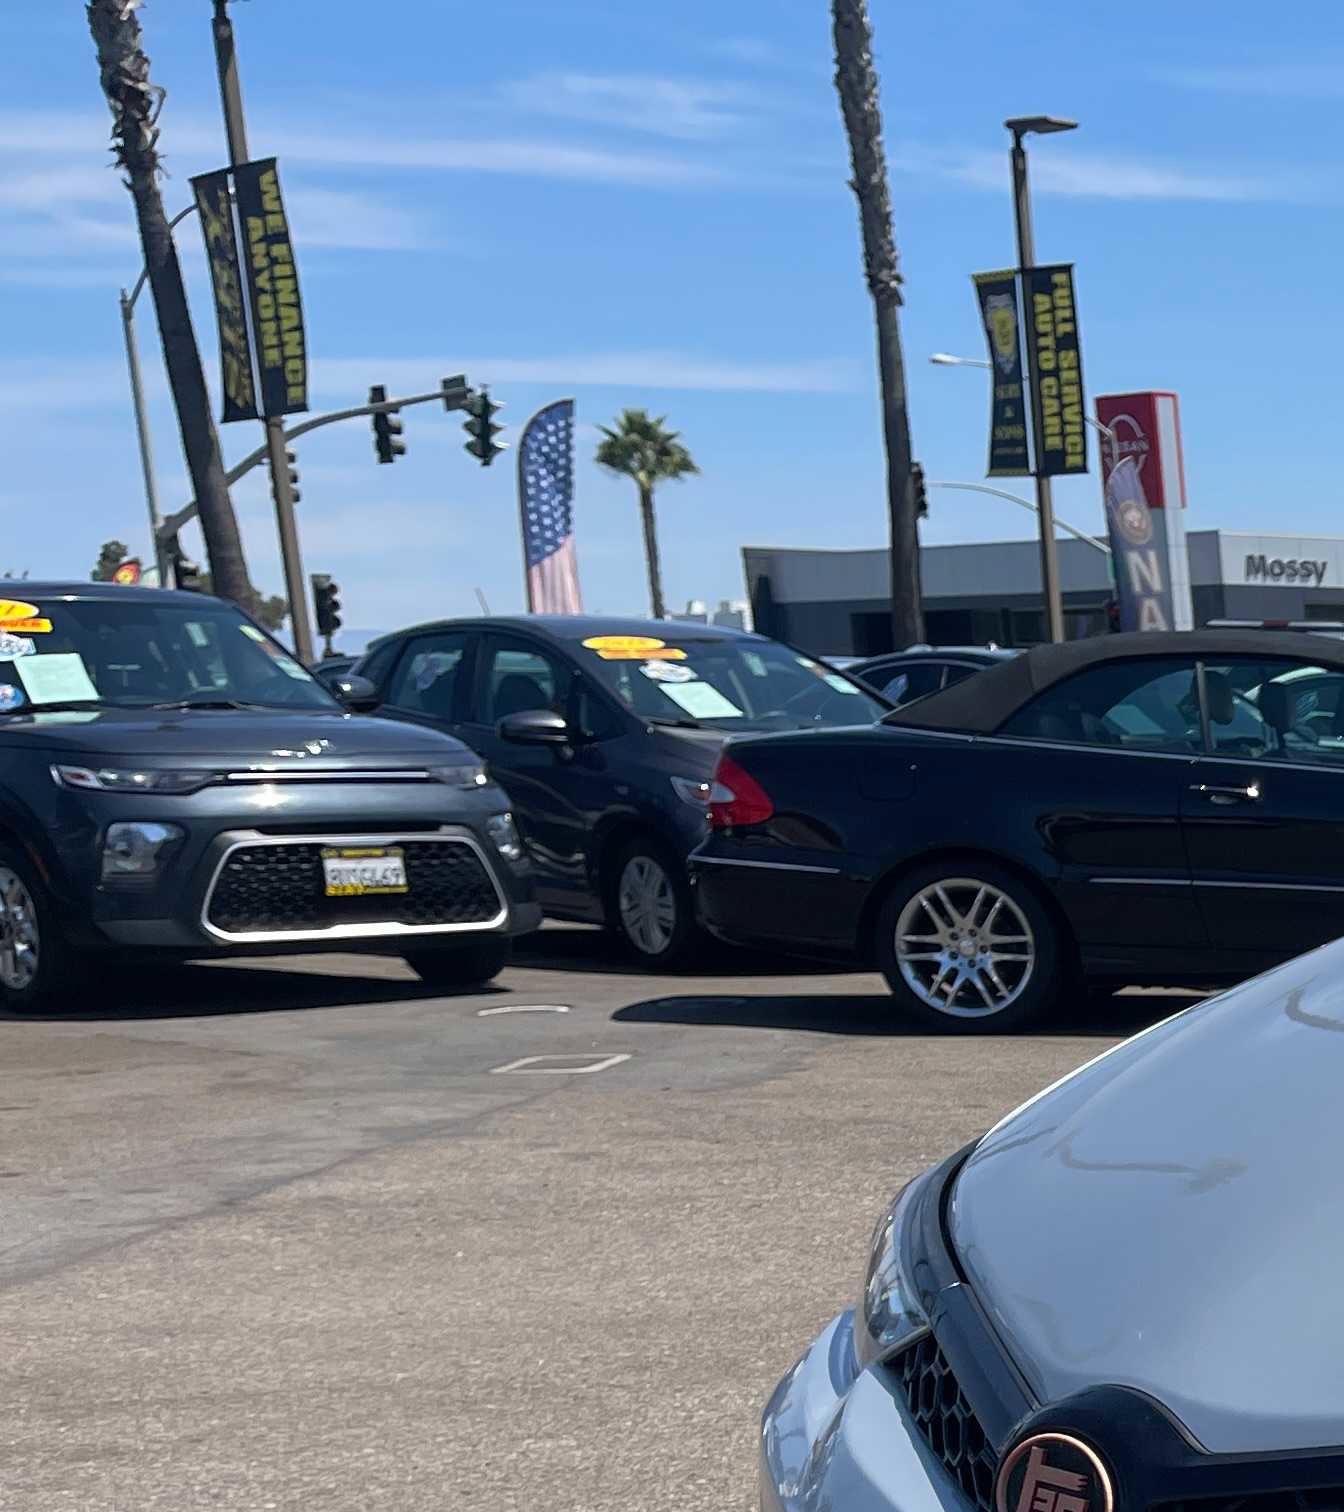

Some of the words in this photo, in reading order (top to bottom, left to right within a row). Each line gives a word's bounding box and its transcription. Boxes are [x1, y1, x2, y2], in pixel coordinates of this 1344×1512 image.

[259, 169, 286, 233] WE
[247, 216, 282, 367] ANYONE
[270, 243, 306, 406] FINANCE
[1052, 272, 1074, 337] FULL
[1033, 293, 1057, 370] AUTO
[1040, 376, 1064, 450] CARE
[1058, 350, 1084, 468] SERVICE
[1244, 554, 1327, 587] Mossy
